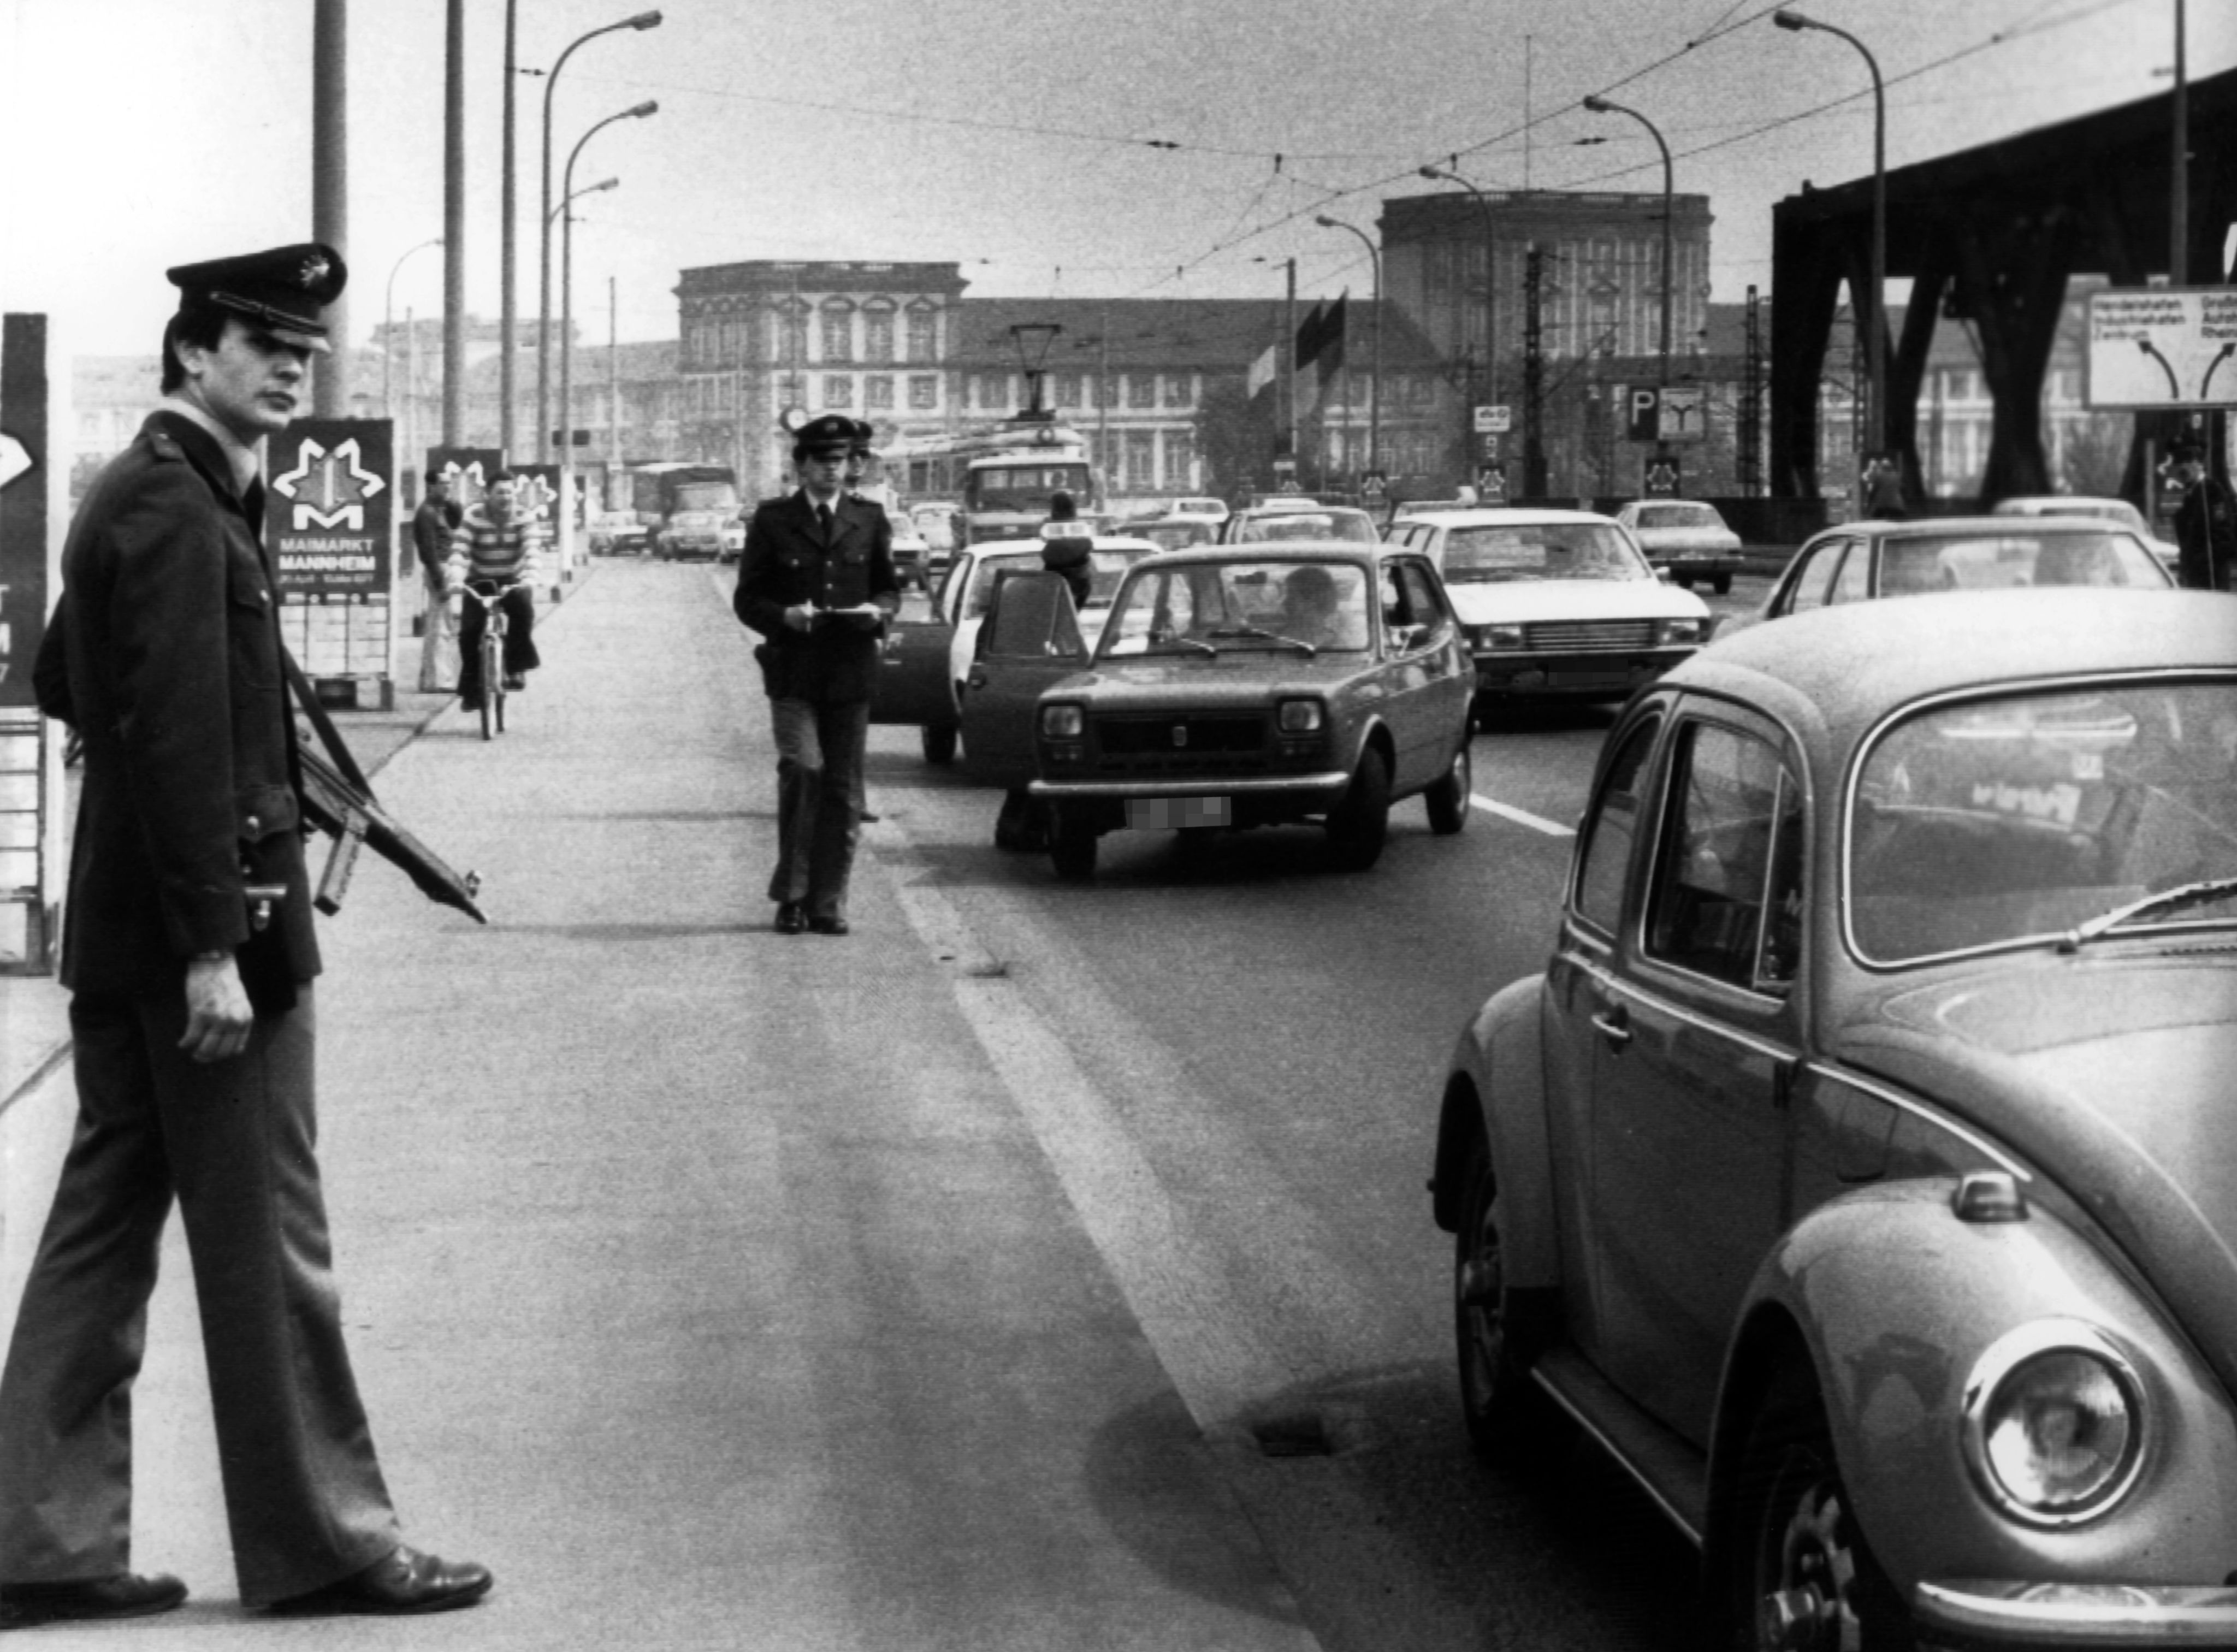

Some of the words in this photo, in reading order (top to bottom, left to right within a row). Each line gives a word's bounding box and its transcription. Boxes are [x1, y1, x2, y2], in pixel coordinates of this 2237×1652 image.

[1632, 390, 1655, 425] P
[280, 538, 375, 552] MAIMARKT
[279, 555, 376, 571] MANNHEIM
